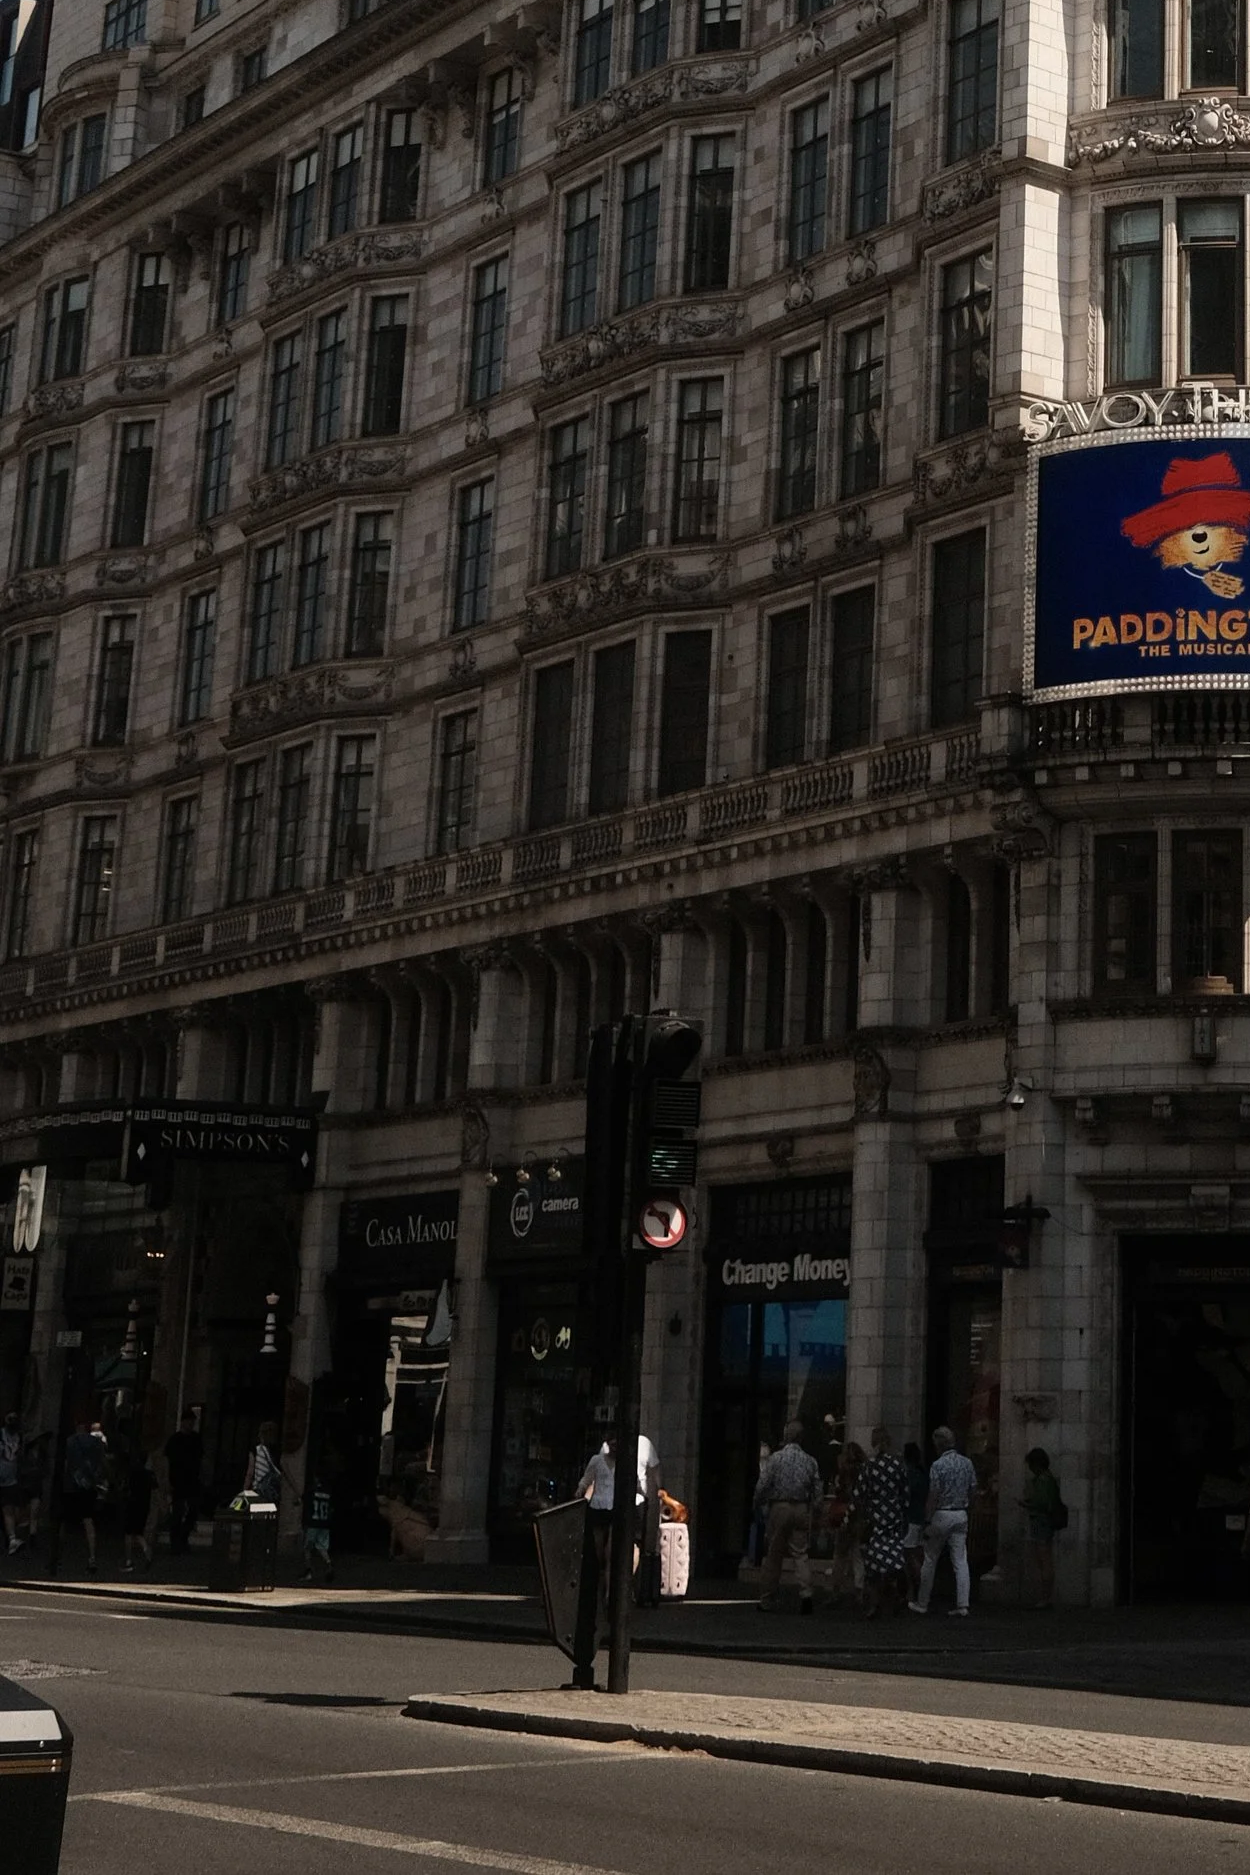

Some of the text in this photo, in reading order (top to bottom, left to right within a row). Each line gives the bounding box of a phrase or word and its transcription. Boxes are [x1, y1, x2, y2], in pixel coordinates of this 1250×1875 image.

[1025, 390, 1175, 443] SAVOY
[1139, 645, 1171, 657] THE
[160, 1128, 291, 1154] SIMPSON'S
[541, 1197, 579, 1212] camera
[722, 1253, 850, 1290] Change Money
